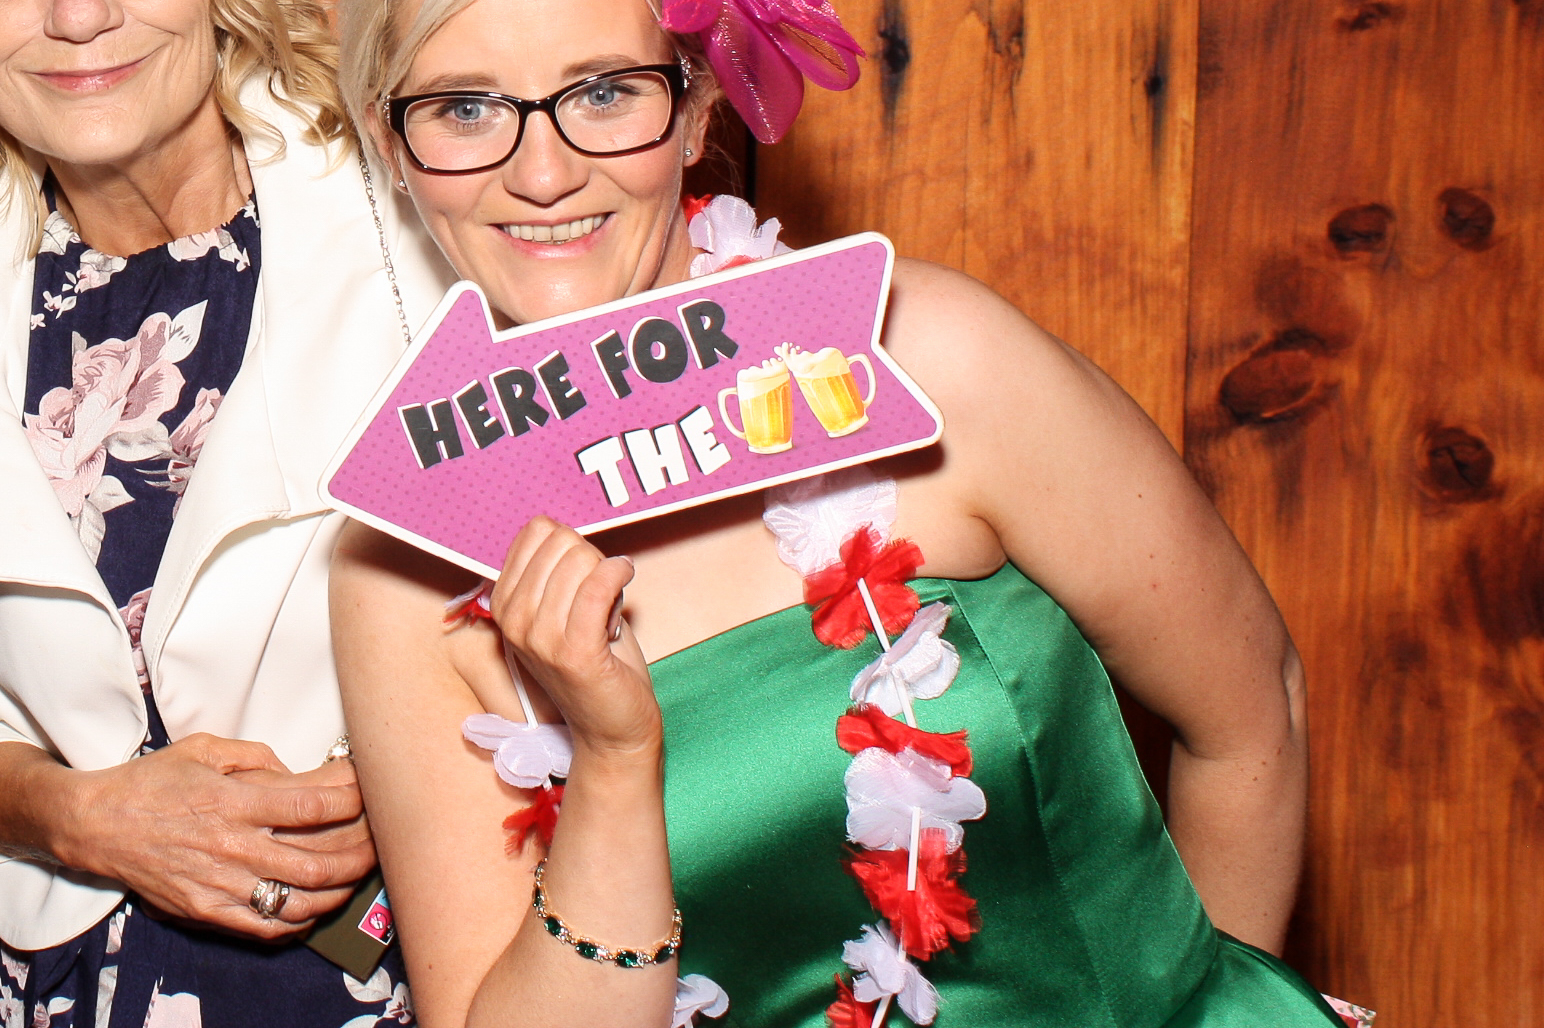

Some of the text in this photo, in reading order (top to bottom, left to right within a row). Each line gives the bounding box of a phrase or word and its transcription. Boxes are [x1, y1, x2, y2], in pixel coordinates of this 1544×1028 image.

[398, 298, 738, 470] HERE FOR
[575, 405, 732, 507] THE
